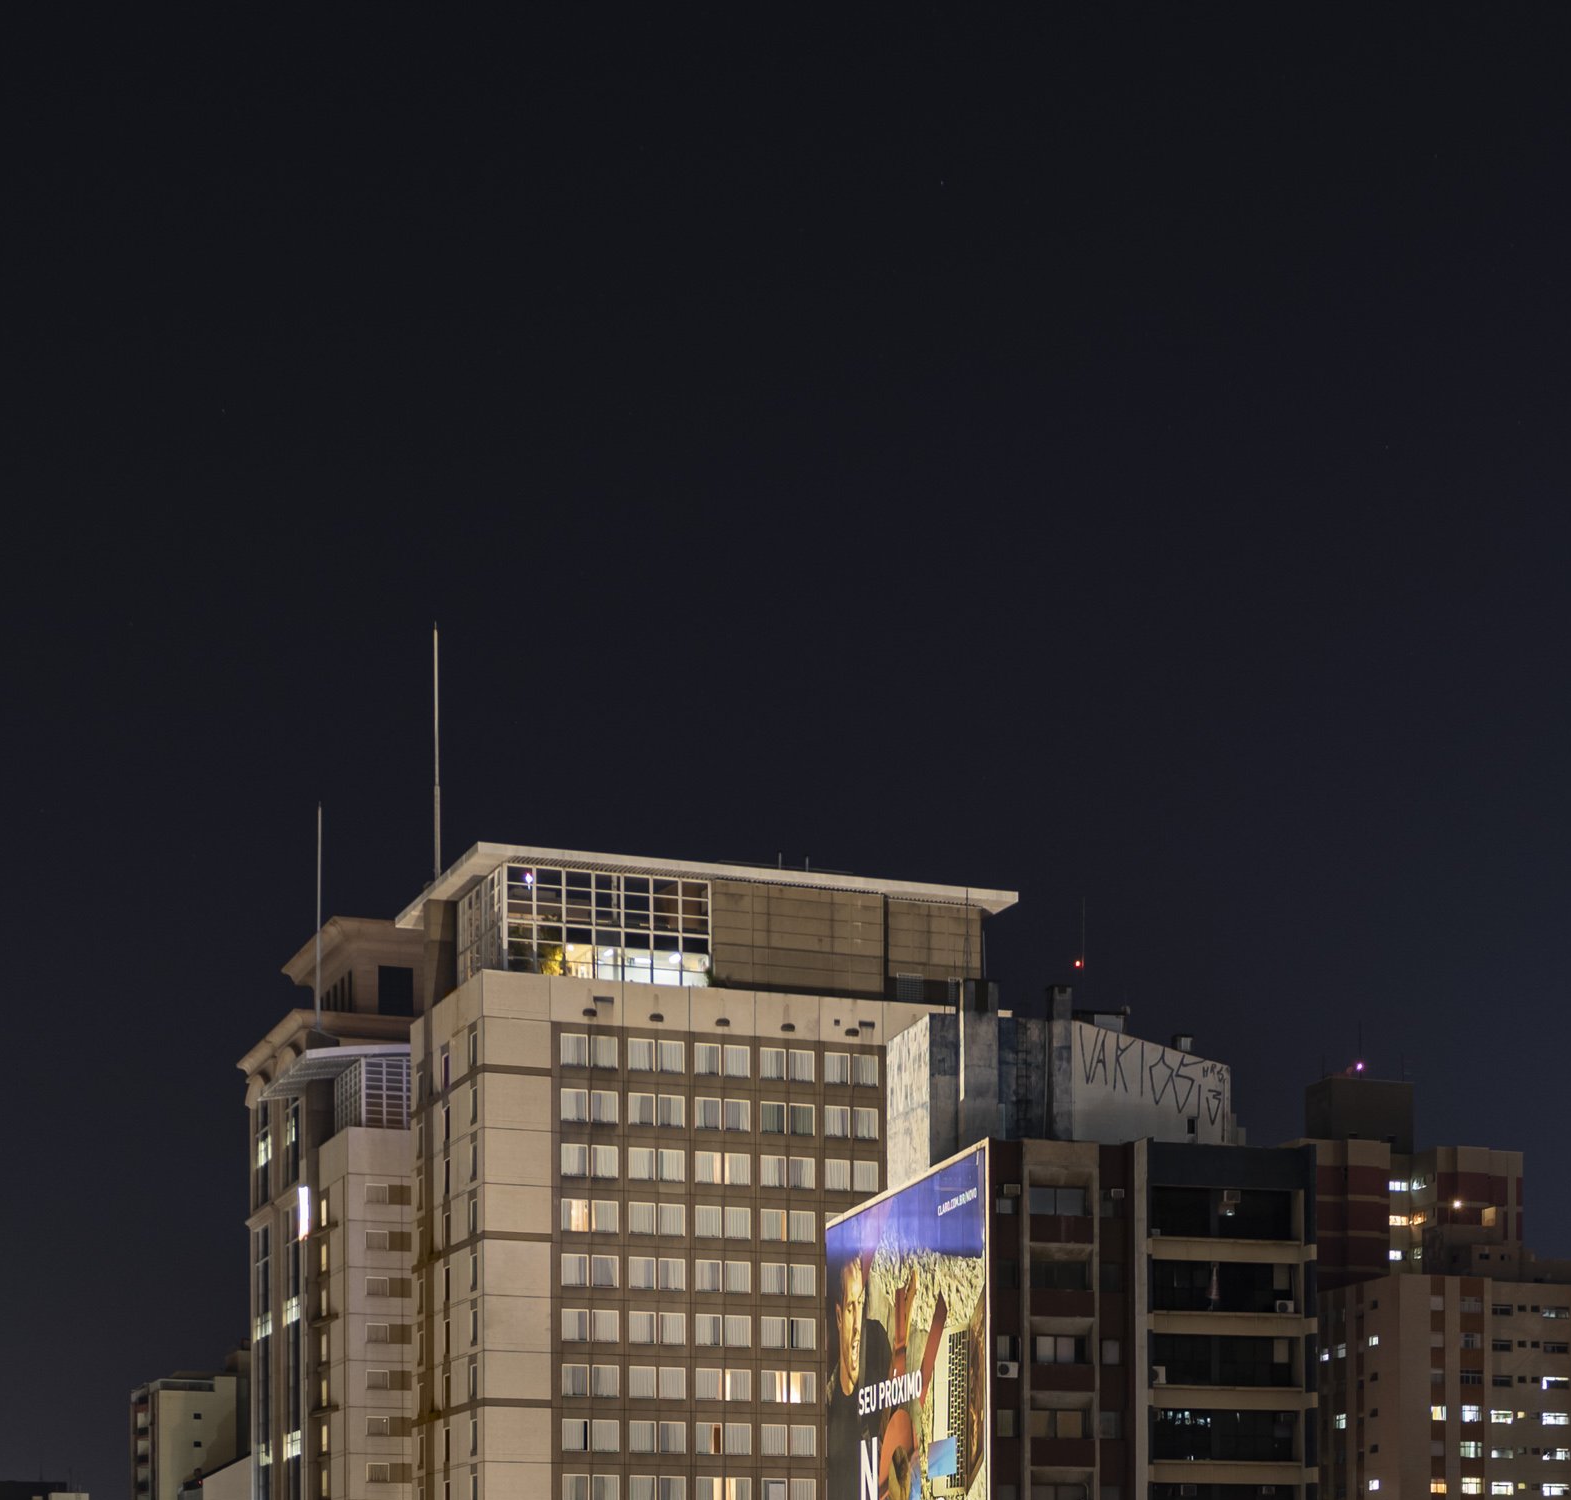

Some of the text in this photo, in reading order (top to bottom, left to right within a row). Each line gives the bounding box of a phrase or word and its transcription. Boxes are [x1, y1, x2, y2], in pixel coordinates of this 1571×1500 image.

[937, 1187, 979, 1217] CLARO.COM.BR/NOVO
[858, 1369, 922, 1416] SEU PRÓXIMO
